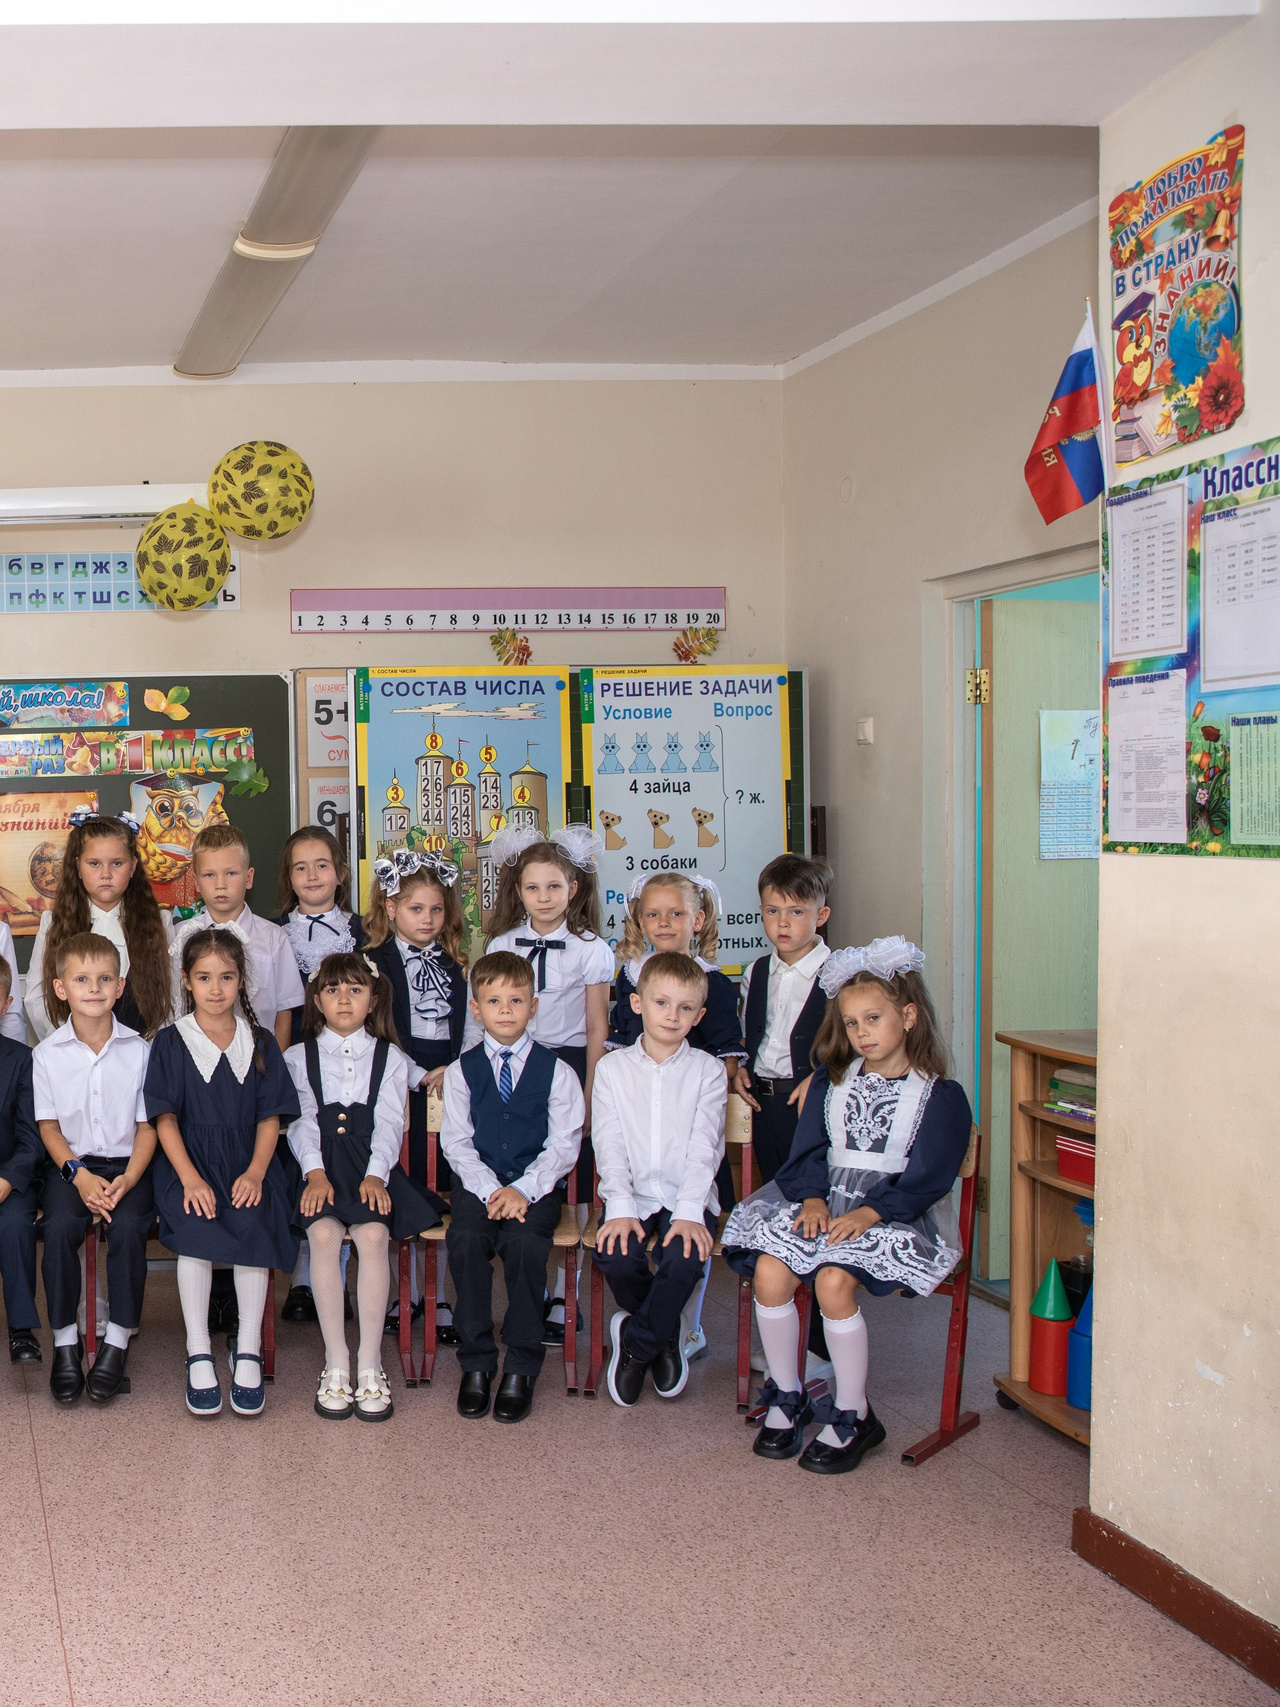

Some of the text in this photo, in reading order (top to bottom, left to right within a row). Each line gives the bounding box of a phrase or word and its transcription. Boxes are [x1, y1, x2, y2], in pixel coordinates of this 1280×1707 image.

[1144, 154, 1204, 205] ДОБРО
[1118, 168, 1230, 249] ПОЖАЛОВАТЬ
[1114, 230, 1202, 300] В СТРАНУ
[1153, 254, 1237, 357] ЗНАНИЙ!
[1202, 453, 1280, 501] Классн
[1200, 514, 1216, 524] Наш
[1217, 508, 1237, 520] класс
[8, 558, 22, 575] б
[31, 562, 44, 575] в
[54, 561, 64, 575] г
[72, 561, 88, 577] д
[92, 561, 110, 574] ж
[116, 560, 129, 574] з
[9, 592, 22, 605] п
[28, 588, 47, 608] ф
[53, 592, 65, 604] к
[74, 591, 87, 604] т
[93, 590, 111, 603] ш
[117, 590, 130, 603] с
[222, 589, 236, 602] ь
[297, 612, 720, 627] 1 2 3 4 5 6 7 8 9 10 11 12 13 14 15 16 17 18 19 20
[1108, 671, 1170, 688] Правила поведения
[314, 683, 346, 693] СЛАГАЕМОЕ
[380, 679, 546, 697] СОСТАВ ЧИСЛА
[600, 680, 693, 698] РЕШЕНИЕ
[699, 679, 773, 698] ЗАДАЧИ
[21, 690, 104, 709] школа!
[602, 702, 773, 720] Условие Вопрос
[1231, 714, 1278, 726] Наши планы
[429, 733, 439, 750] 8
[98, 741, 118, 772] В
[124, 735, 146, 773] 1
[484, 747, 492, 762] 5
[31, 757, 65, 774] РАЗ
[422, 760, 442, 775] 1 7
[455, 761, 464, 777] 6
[422, 777, 442, 792] 2 6
[629, 779, 691, 796] 4 зайца
[391, 786, 400, 802] 3
[422, 793, 443, 808] 3 5
[451, 788, 470, 804] 1 5
[517, 787, 526, 803] 4
[423, 809, 443, 825] 4 4
[451, 805, 471, 820] 2 4
[387, 815, 406, 830] 1 2
[451, 821, 470, 837] 3 3
[494, 815, 503, 830] 7
[426, 836, 443, 851] 10
[626, 855, 698, 872] 3 собаки
[607, 914, 616, 929] 4
[727, 913, 764, 925] всег
